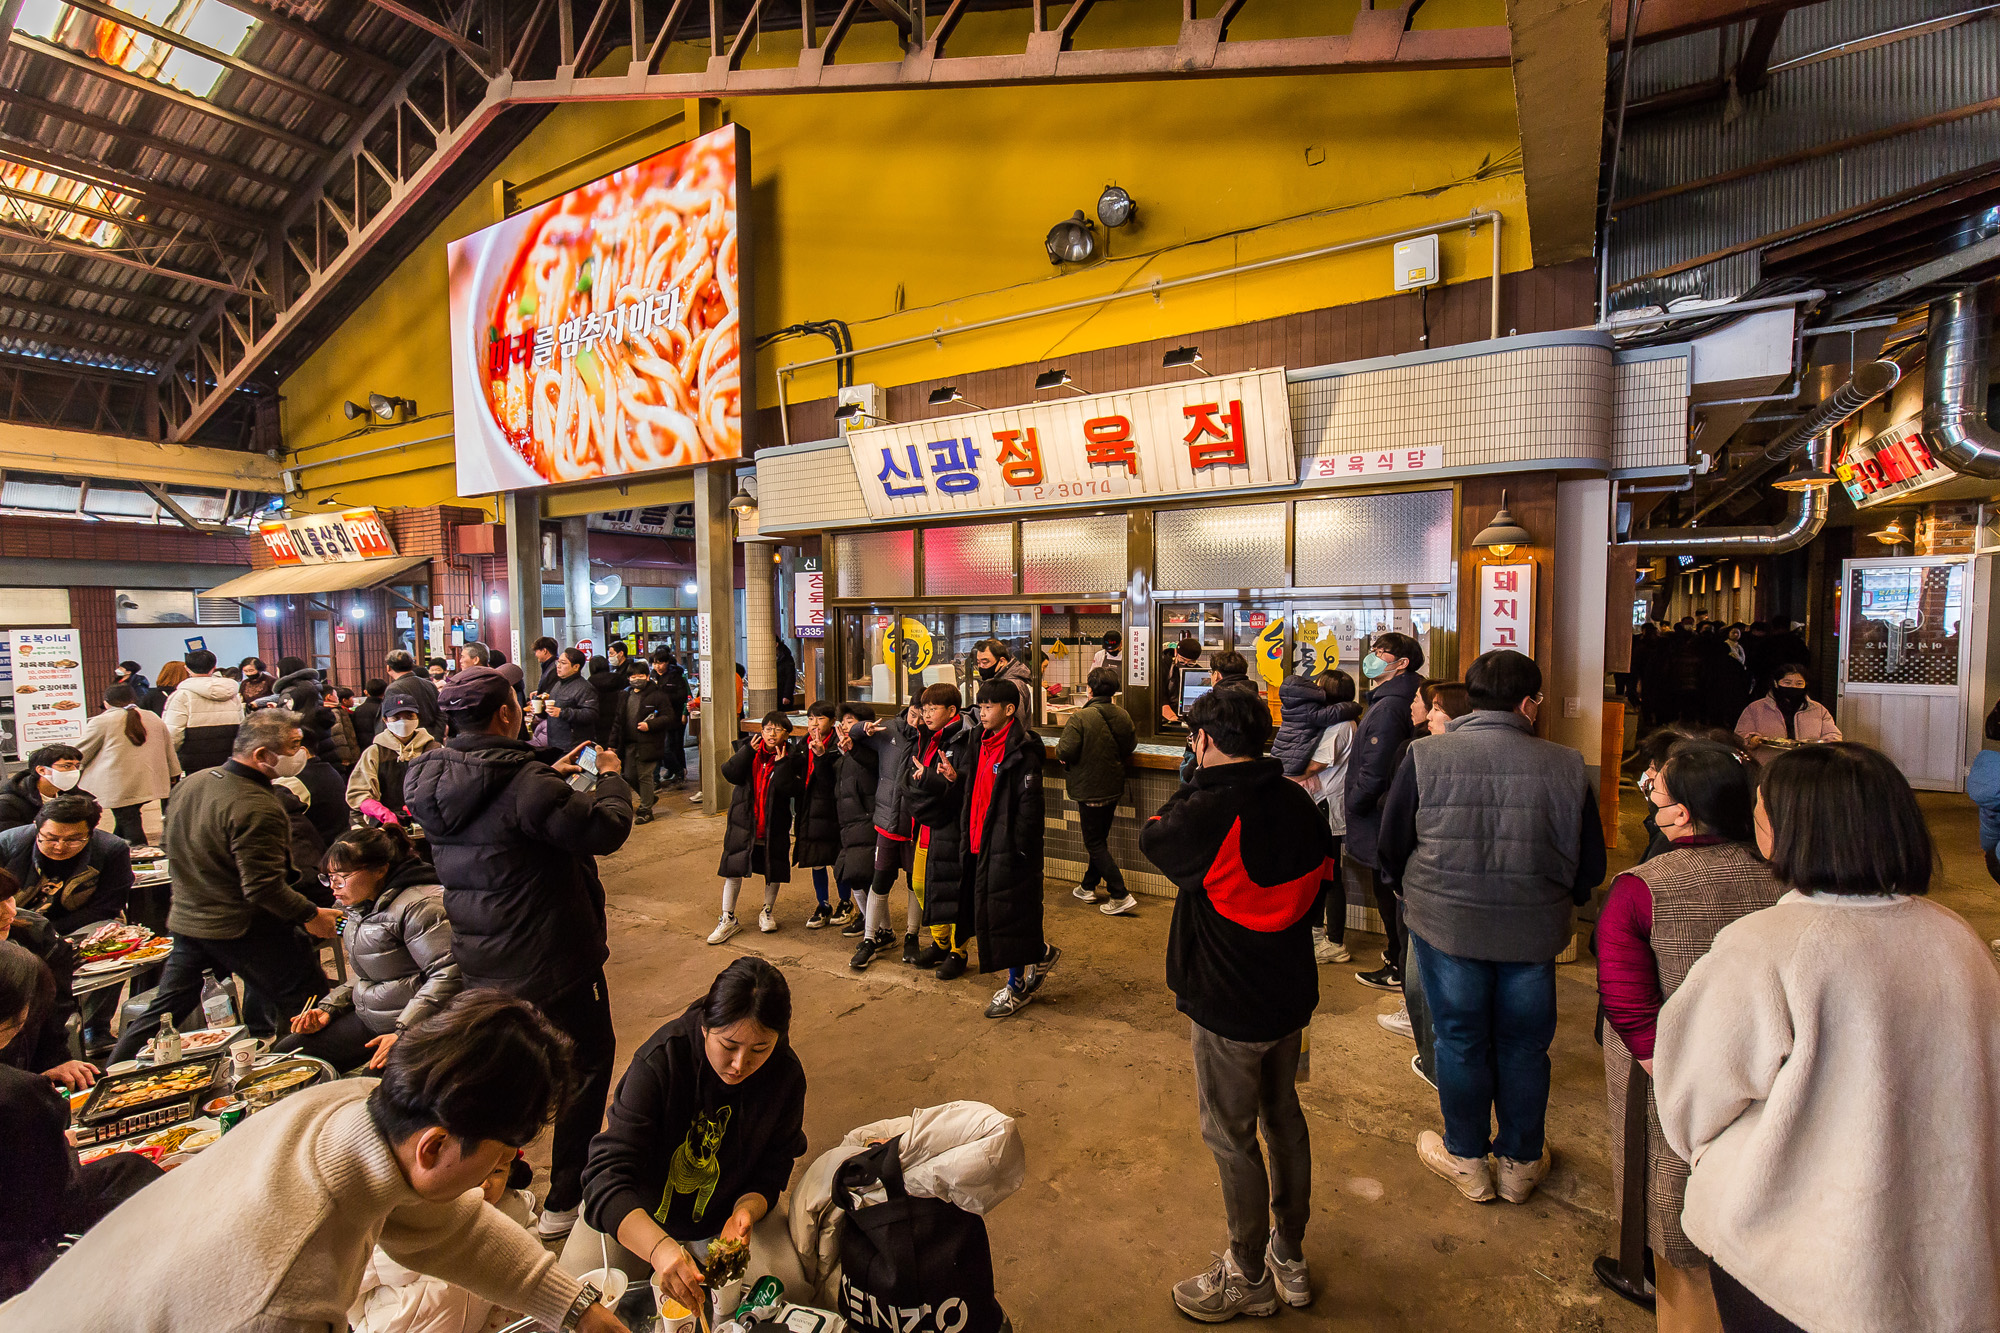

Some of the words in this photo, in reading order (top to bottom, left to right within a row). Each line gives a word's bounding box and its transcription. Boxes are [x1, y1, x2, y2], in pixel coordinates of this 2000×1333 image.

[488, 327, 555, 372] 마라를
[558, 303, 627, 360] 멈추지
[629, 287, 682, 338] 마라
[878, 436, 981, 499] 신광
[992, 399, 1248, 487] 정육점
[1319, 450, 1426, 476] 정육식당
[290, 522, 356, 556] 대흥상회
